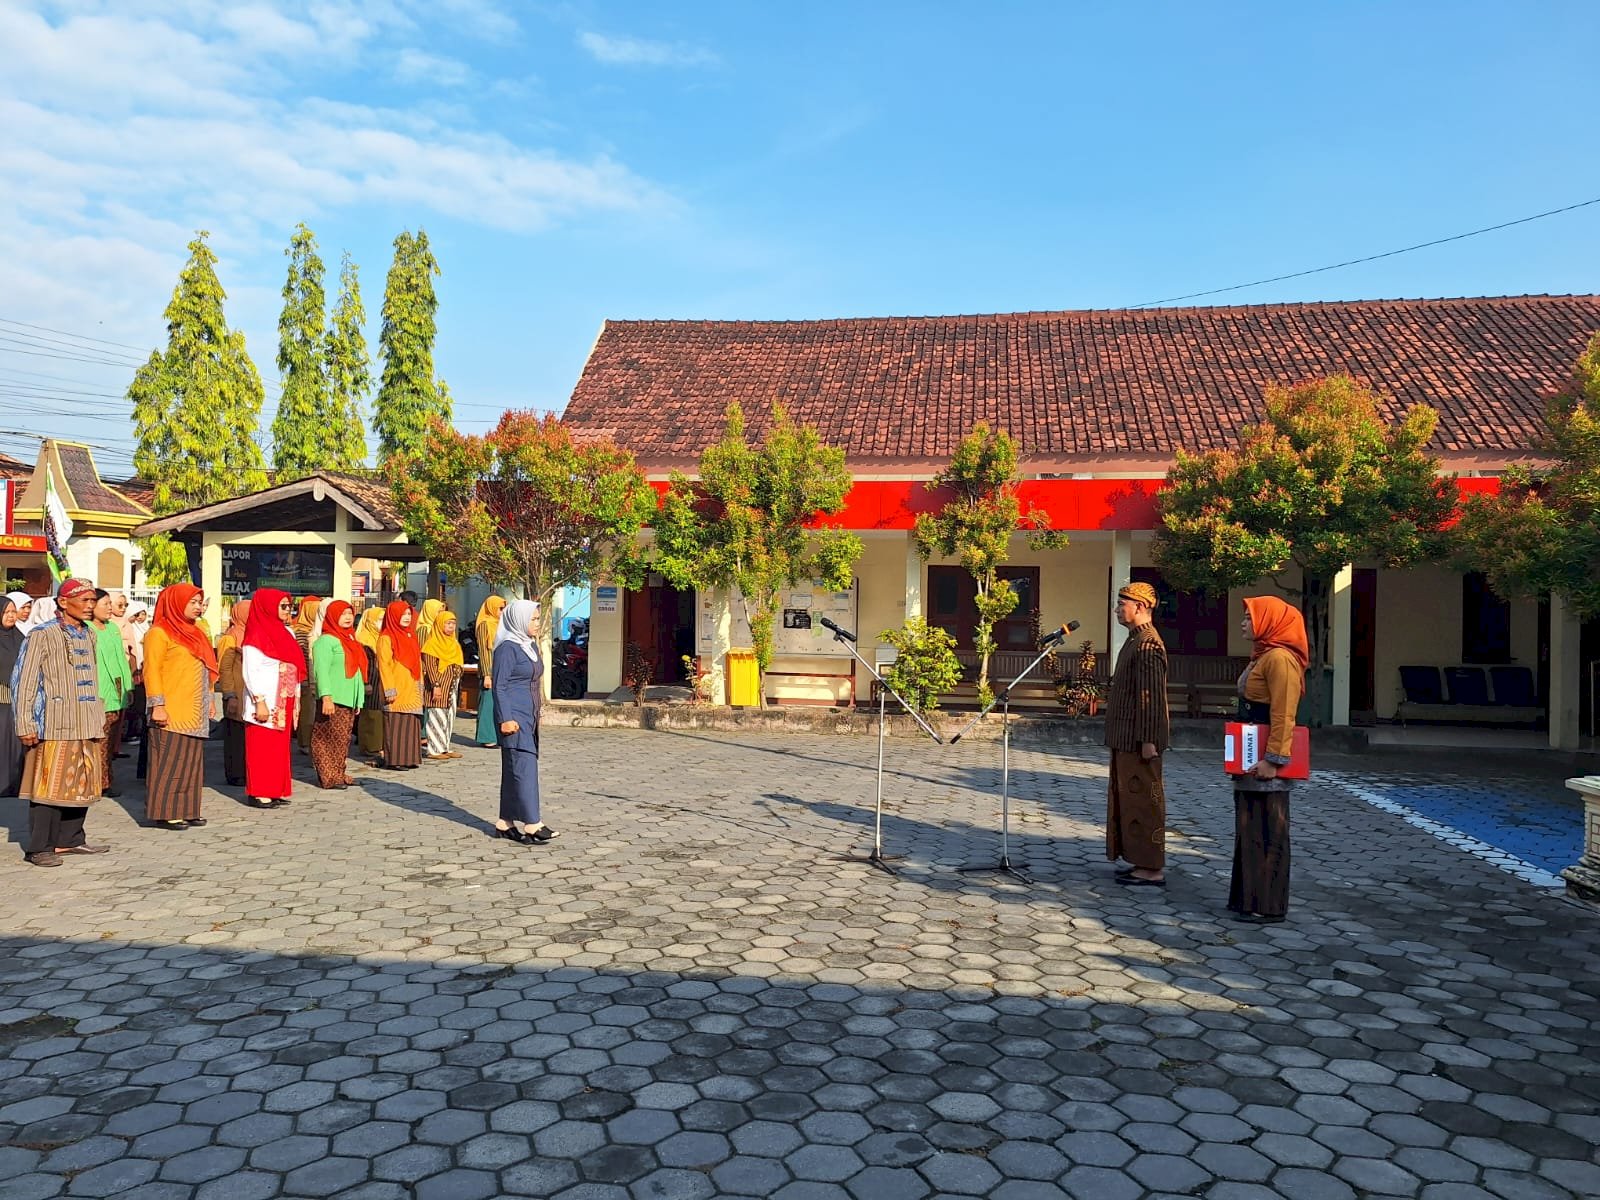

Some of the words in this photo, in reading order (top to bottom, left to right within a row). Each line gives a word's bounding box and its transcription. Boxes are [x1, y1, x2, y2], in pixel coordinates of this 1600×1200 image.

[0, 536, 33, 547] CUK
[222, 549, 251, 560] LAPOR
[222, 581, 251, 593] ETAX
